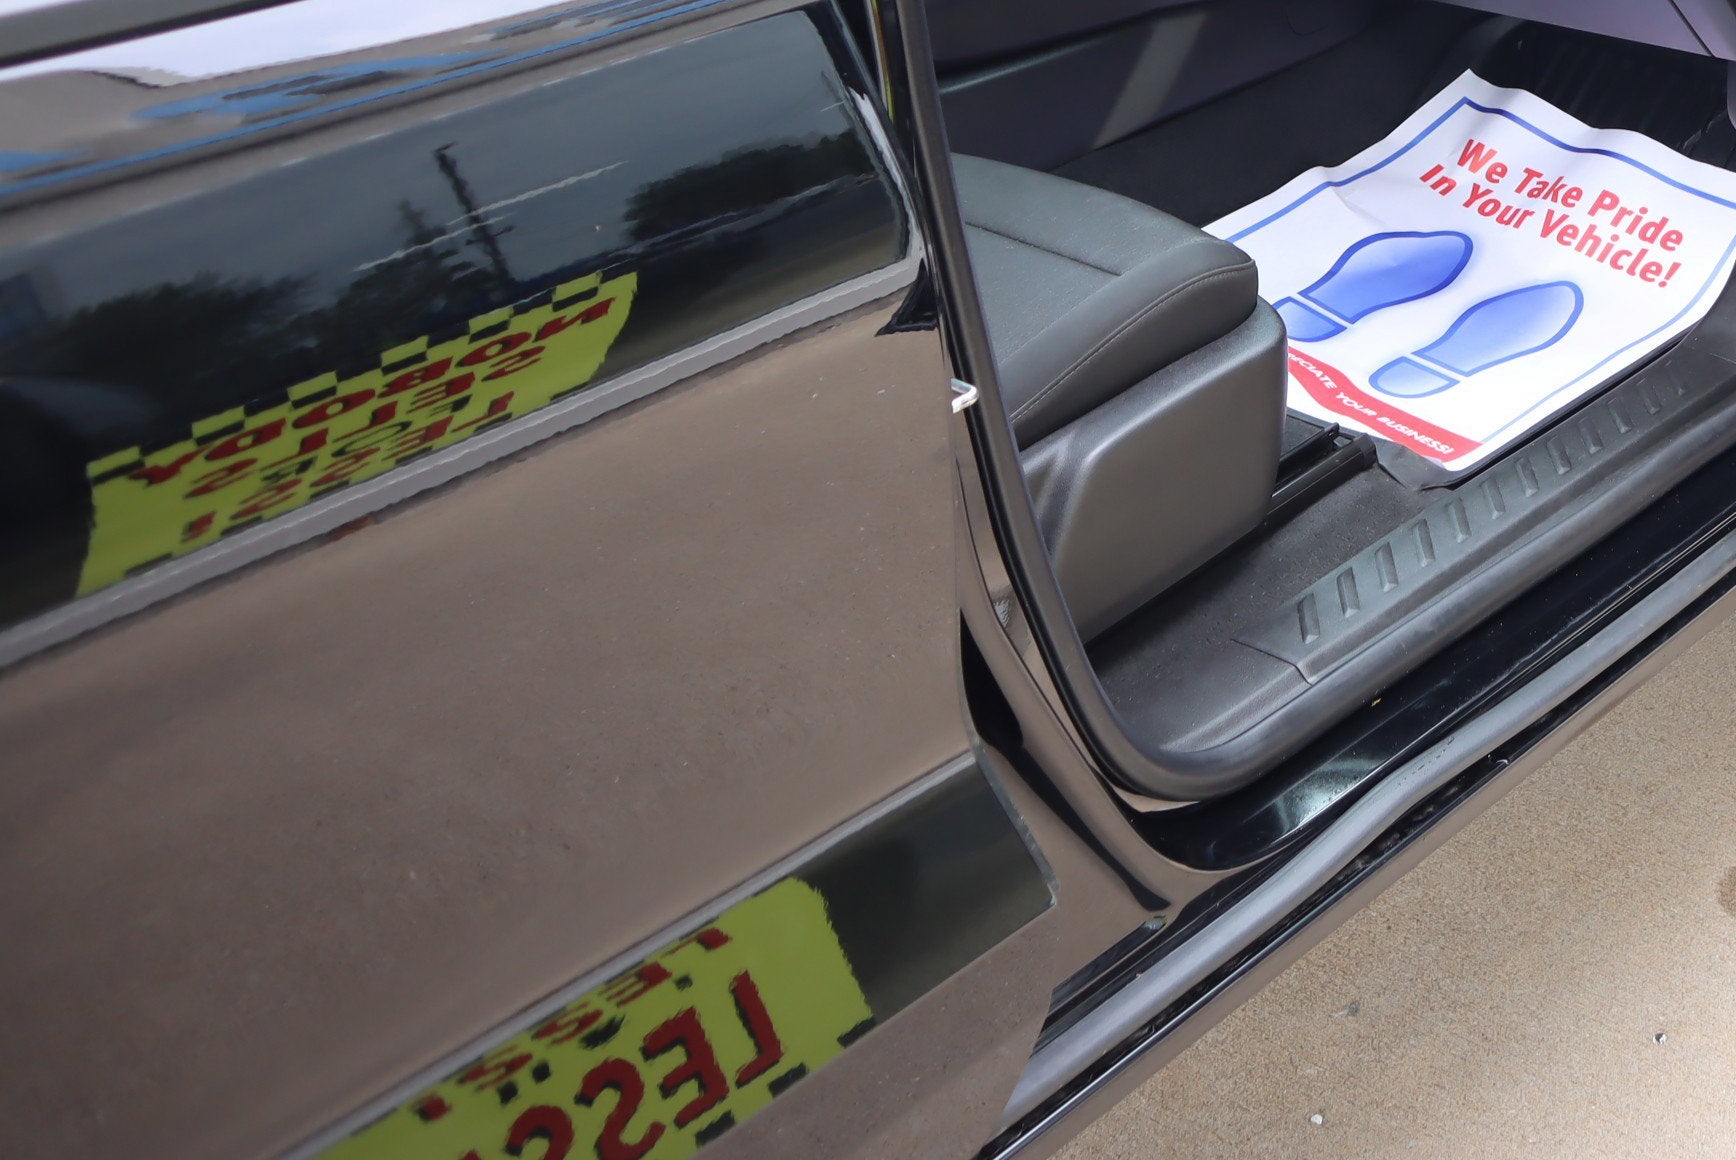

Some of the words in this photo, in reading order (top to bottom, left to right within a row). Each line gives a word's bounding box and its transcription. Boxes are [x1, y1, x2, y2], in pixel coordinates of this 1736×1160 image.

[1419, 163, 1454, 197] In
[1461, 183, 1533, 230] Your
[1540, 209, 1683, 289] Vehicle!
[1457, 138, 1509, 185] We
[1513, 168, 1584, 209] Take
[1590, 189, 1684, 253] Pride
[1335, 391, 1378, 417] YOUR
[1376, 416, 1456, 455] BUSINESS!
